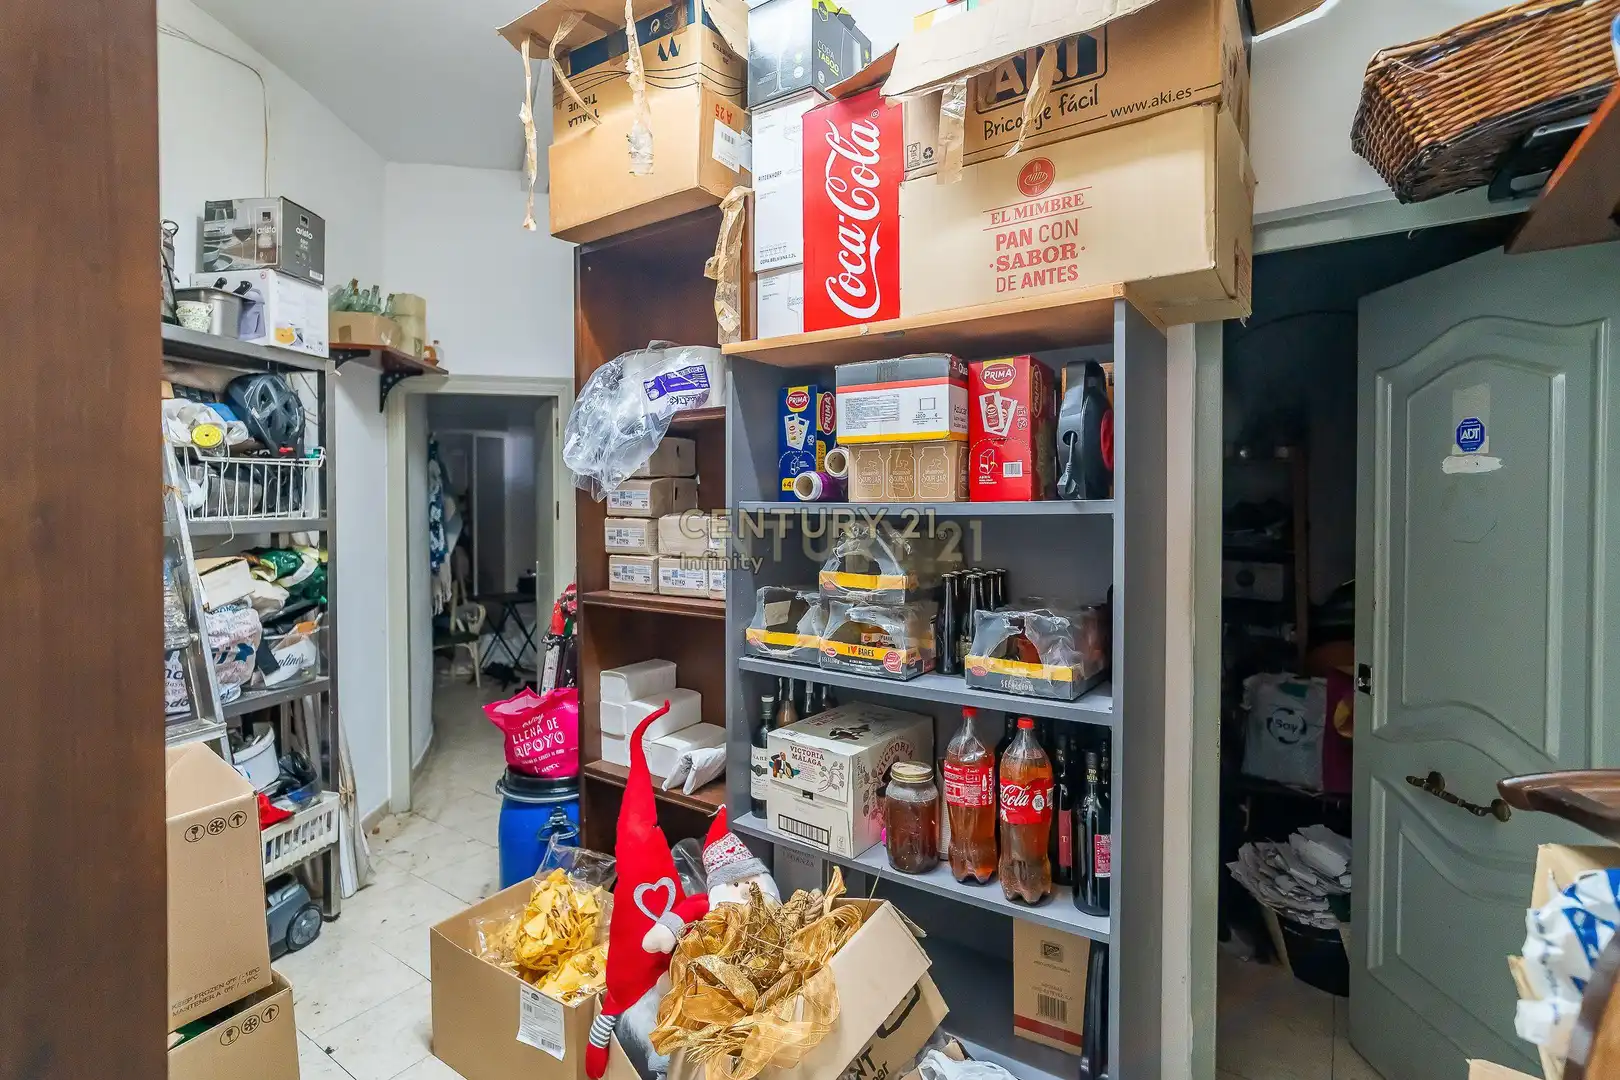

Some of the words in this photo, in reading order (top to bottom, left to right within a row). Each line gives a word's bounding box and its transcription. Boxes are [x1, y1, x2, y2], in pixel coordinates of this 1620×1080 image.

[715, 103, 725, 120] 25
[1059, 83, 1099, 117] fácil
[1110, 86, 1192, 118] www.aki.es
[726, 111, 733, 124] A
[825, 119, 881, 319] Coca-Cola
[990, 209, 1010, 226] EL
[1014, 193, 1084, 221] MIMBRE
[996, 228, 1032, 251] PAN
[1039, 218, 1079, 243] CON
[996, 274, 1017, 294] DE
[1021, 264, 1079, 289] ANTES
[984, 369, 1013, 381] PRIMA
[788, 396, 808, 406] PRIMA
[823, 396, 832, 431] PRIMA
[1460, 427, 1480, 441] ADT
[512, 726, 543, 745] LLENA
[546, 717, 560, 731] DE
[790, 745, 825, 760] VICTORIA
[194, 983, 225, 1001] FROZEN
